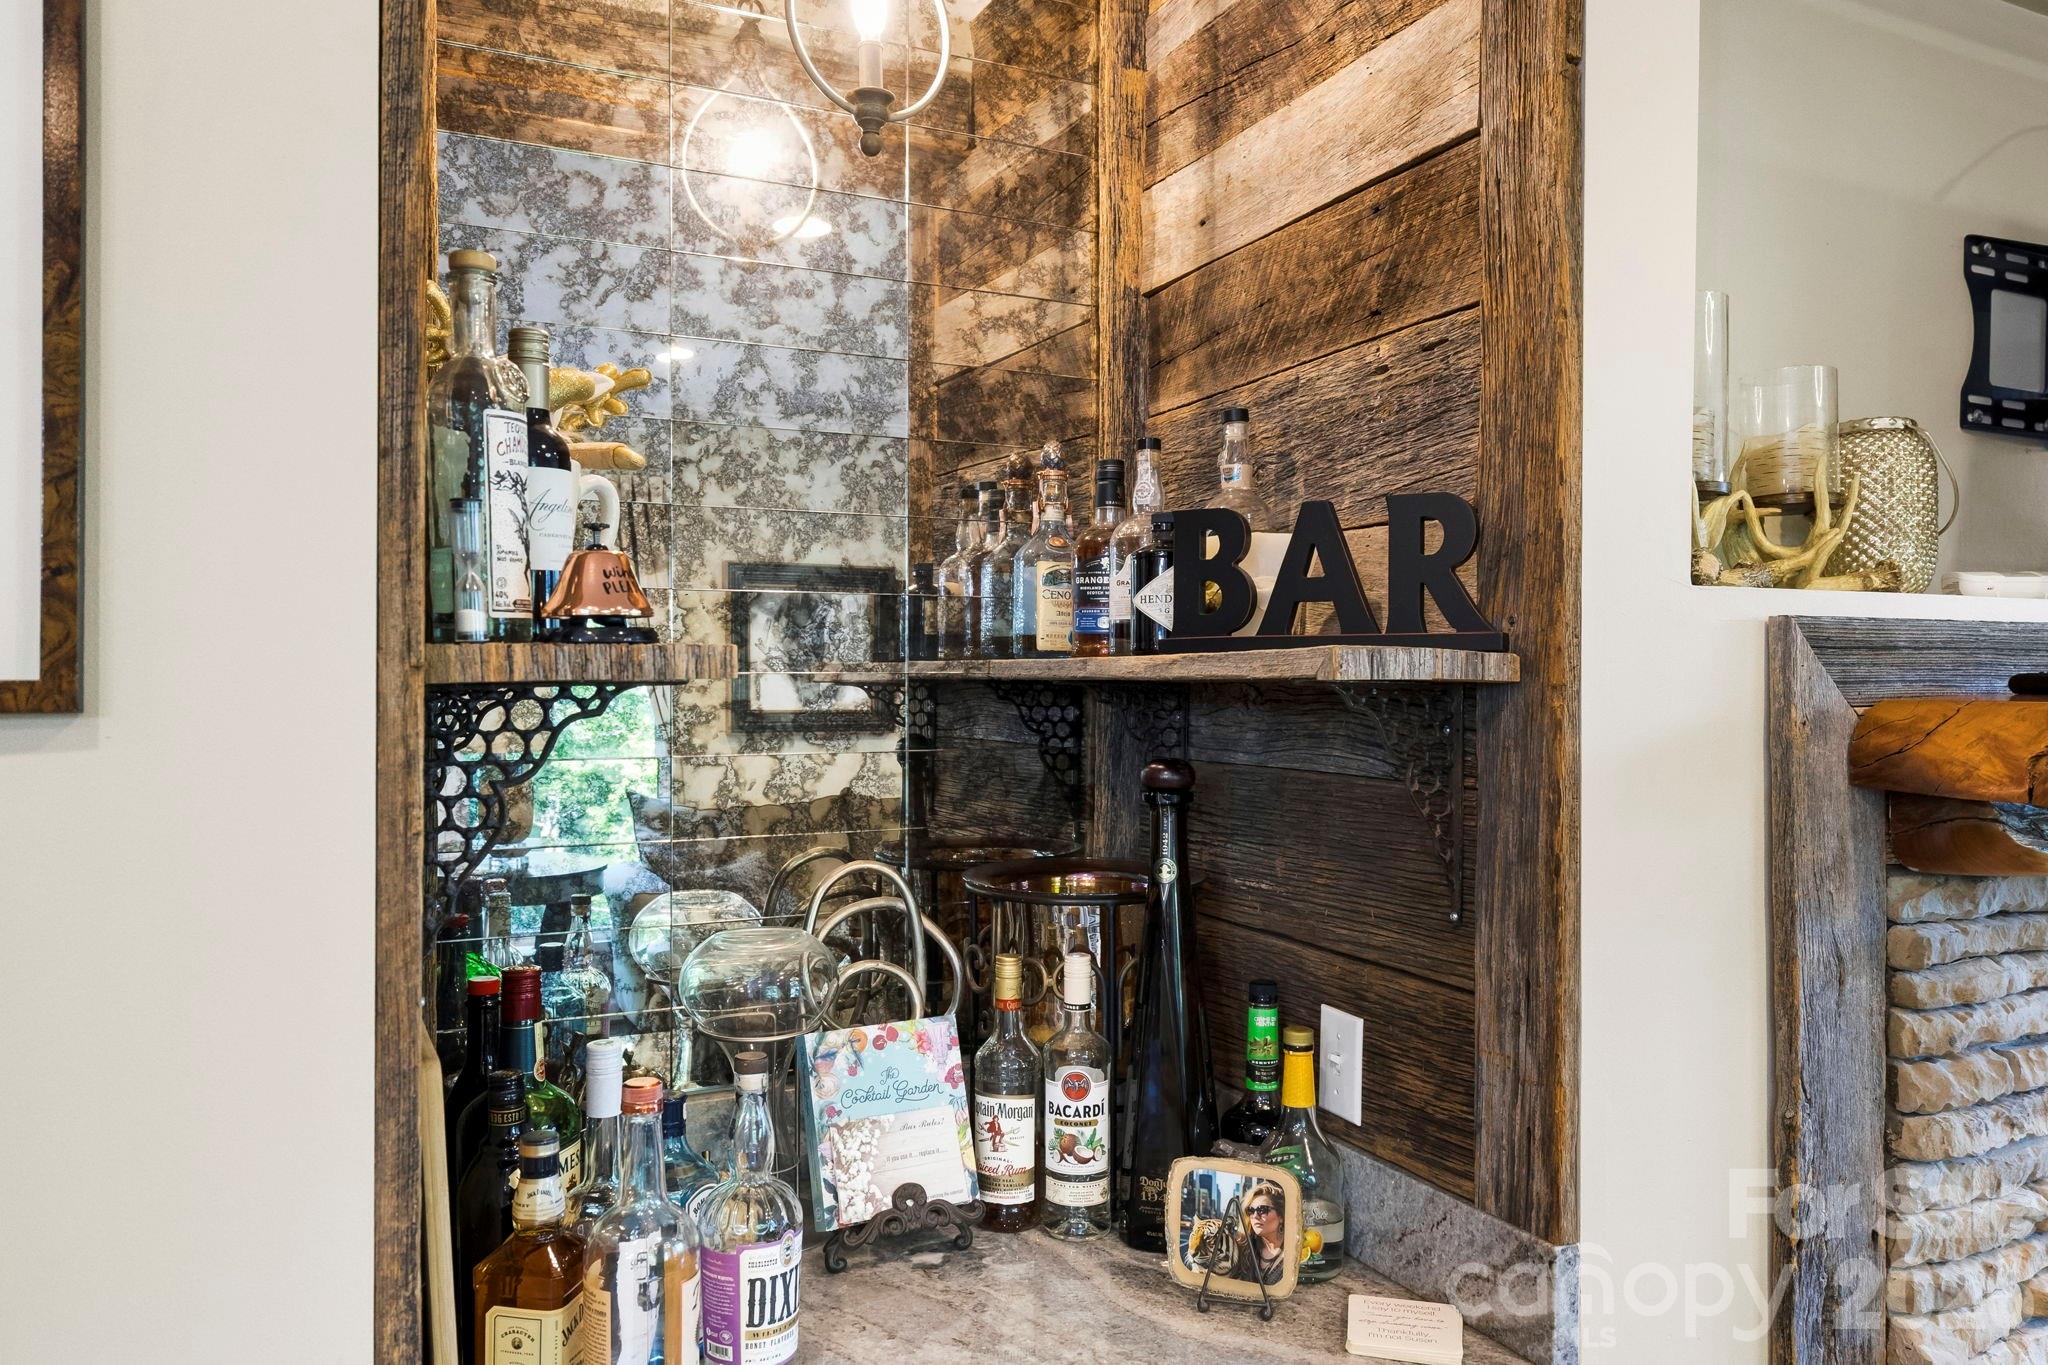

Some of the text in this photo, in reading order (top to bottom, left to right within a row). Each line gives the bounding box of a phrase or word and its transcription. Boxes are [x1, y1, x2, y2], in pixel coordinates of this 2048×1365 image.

[1170, 490, 1498, 640] BAR
[1140, 594, 1173, 604] HEND
[880, 1066, 900, 1085] The
[841, 1079, 944, 1109] Cocktail Garden
[995, 1102, 1034, 1122] Morgan
[1048, 1098, 1105, 1119] BACARDÍ
[1001, 1164, 1028, 1177] Rum
